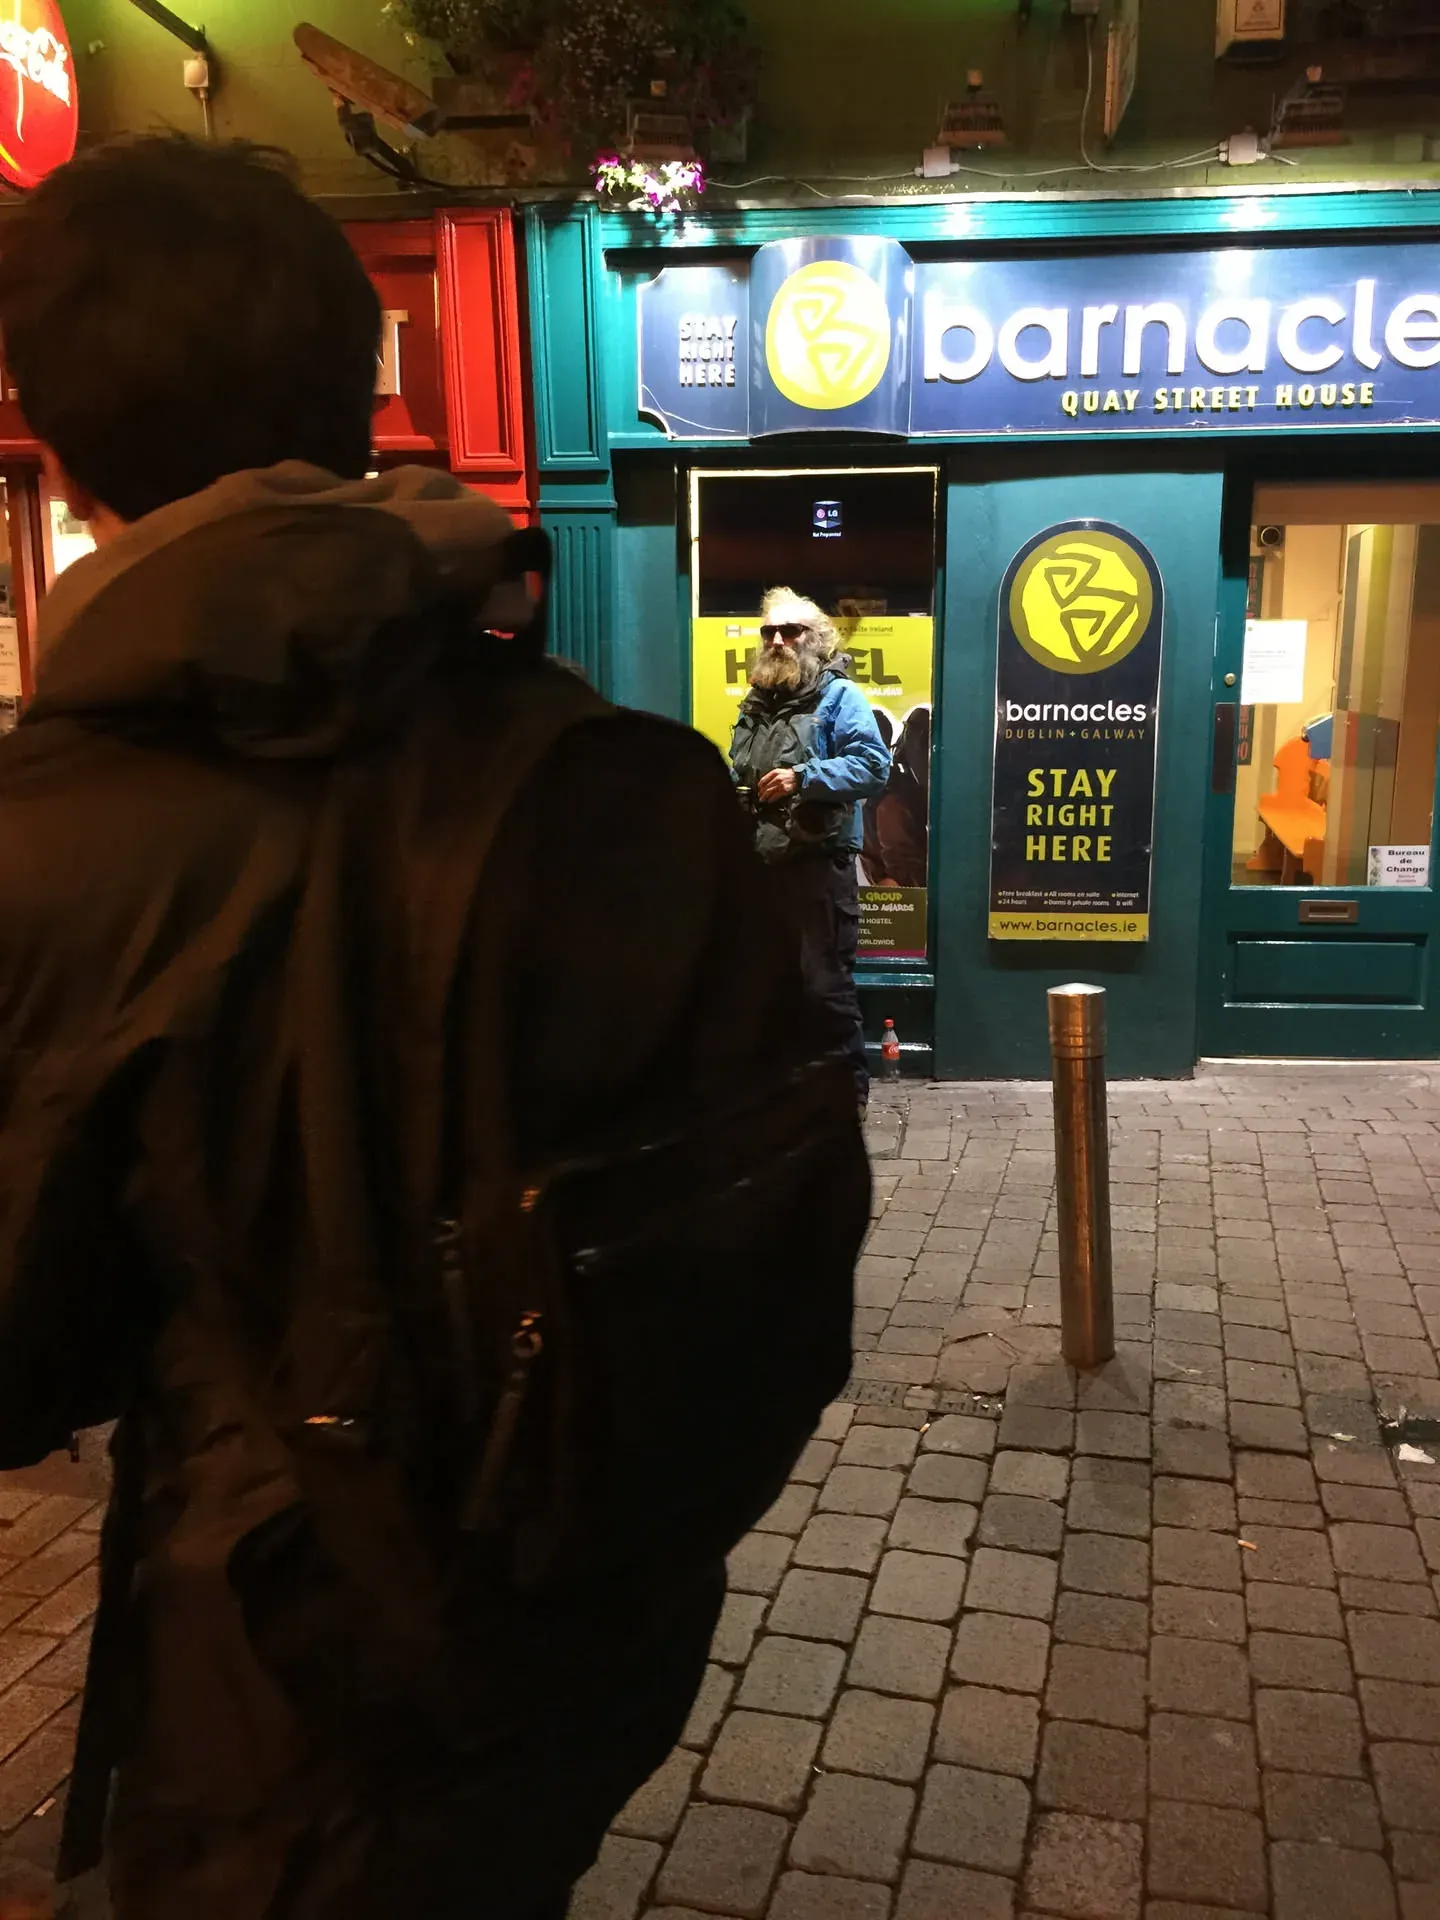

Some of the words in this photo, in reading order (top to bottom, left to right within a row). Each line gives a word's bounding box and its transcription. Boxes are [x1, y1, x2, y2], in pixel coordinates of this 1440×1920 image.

[679, 314, 738, 341] STAY
[679, 341, 735, 363] RIGHT
[679, 363, 736, 388] HERE
[1061, 389, 1142, 418] QUAY
[1153, 385, 1260, 412] STREET
[1275, 382, 1375, 408] HOUSE
[827, 509, 838, 517] LG
[1006, 699, 1147, 722] barnacles
[1027, 768, 1118, 797] STAY
[1026, 804, 1115, 827] RIGHT
[1026, 835, 1113, 862] HERE
[866, 892, 903, 901] GROUP
[1016, 890, 1043, 898] breakfast
[880, 903, 915, 912] AWARDS
[999, 920, 1138, 933] www.barnacles.ie
